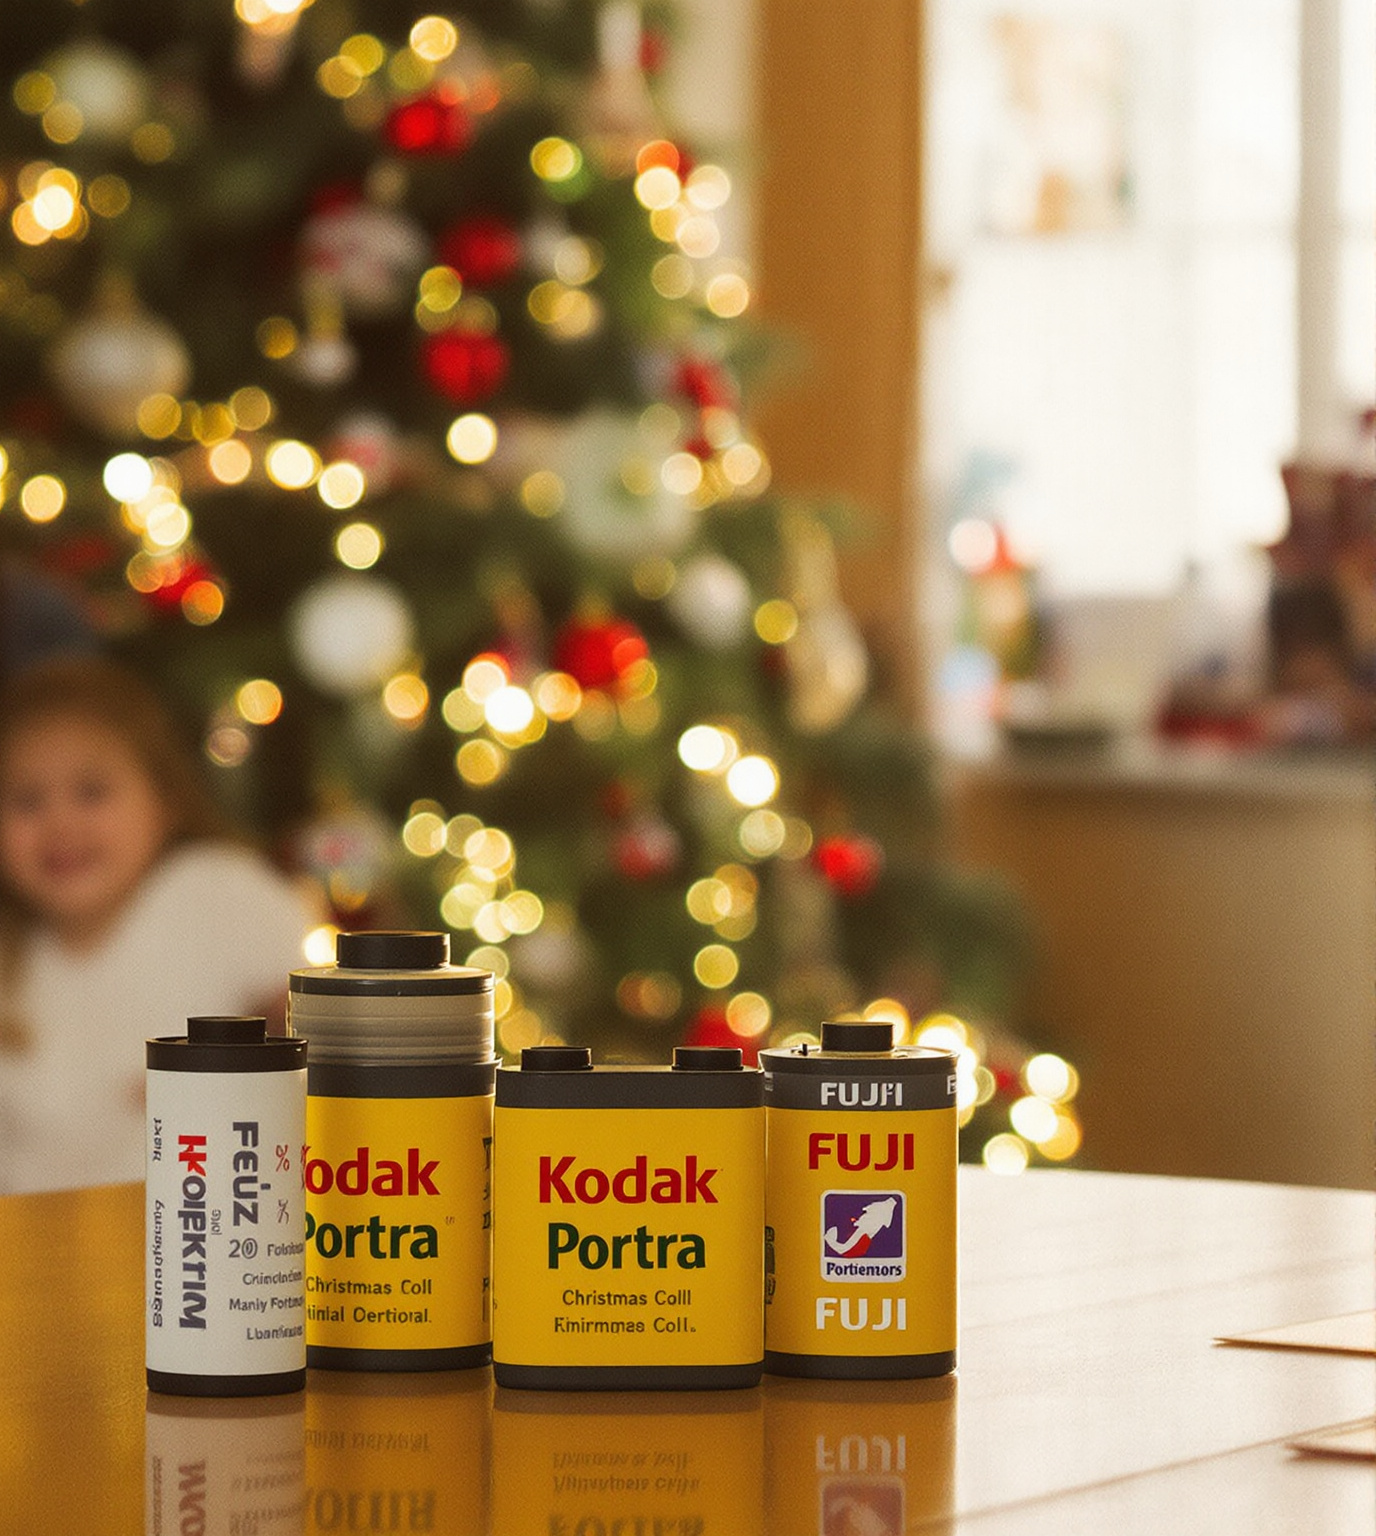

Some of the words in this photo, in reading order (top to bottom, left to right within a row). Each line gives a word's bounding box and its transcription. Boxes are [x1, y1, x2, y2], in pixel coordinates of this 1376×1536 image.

[305, 1147, 441, 1196] odak
[808, 1132, 915, 1171] FUJI
[539, 1155, 719, 1204] Kodak
[548, 1222, 706, 1270] Portra
[562, 1289, 648, 1306] Christmas
[815, 1297, 907, 1331] FUJI
